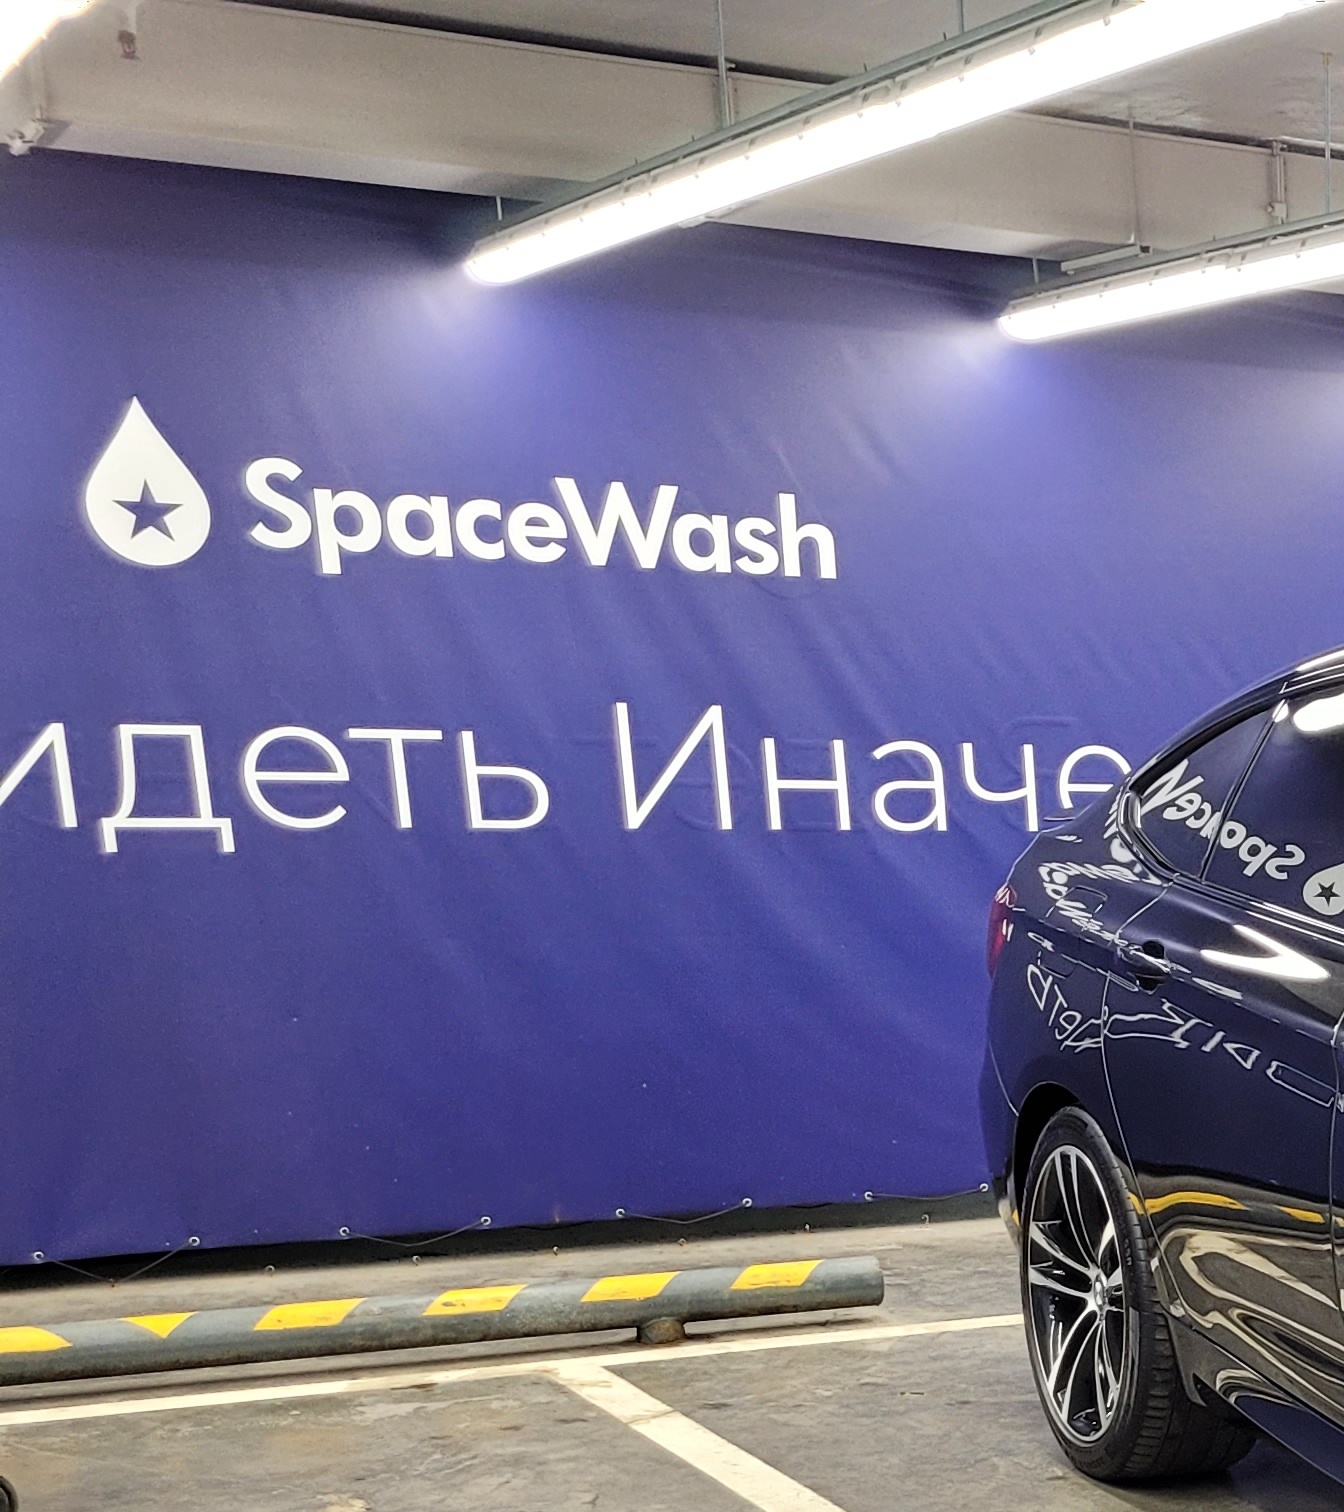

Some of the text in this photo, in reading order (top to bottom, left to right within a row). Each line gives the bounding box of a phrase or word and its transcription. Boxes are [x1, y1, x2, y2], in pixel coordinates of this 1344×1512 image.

[246, 457, 837, 580] SpaceWash
[0, 701, 1132, 853] идеть Иначе
